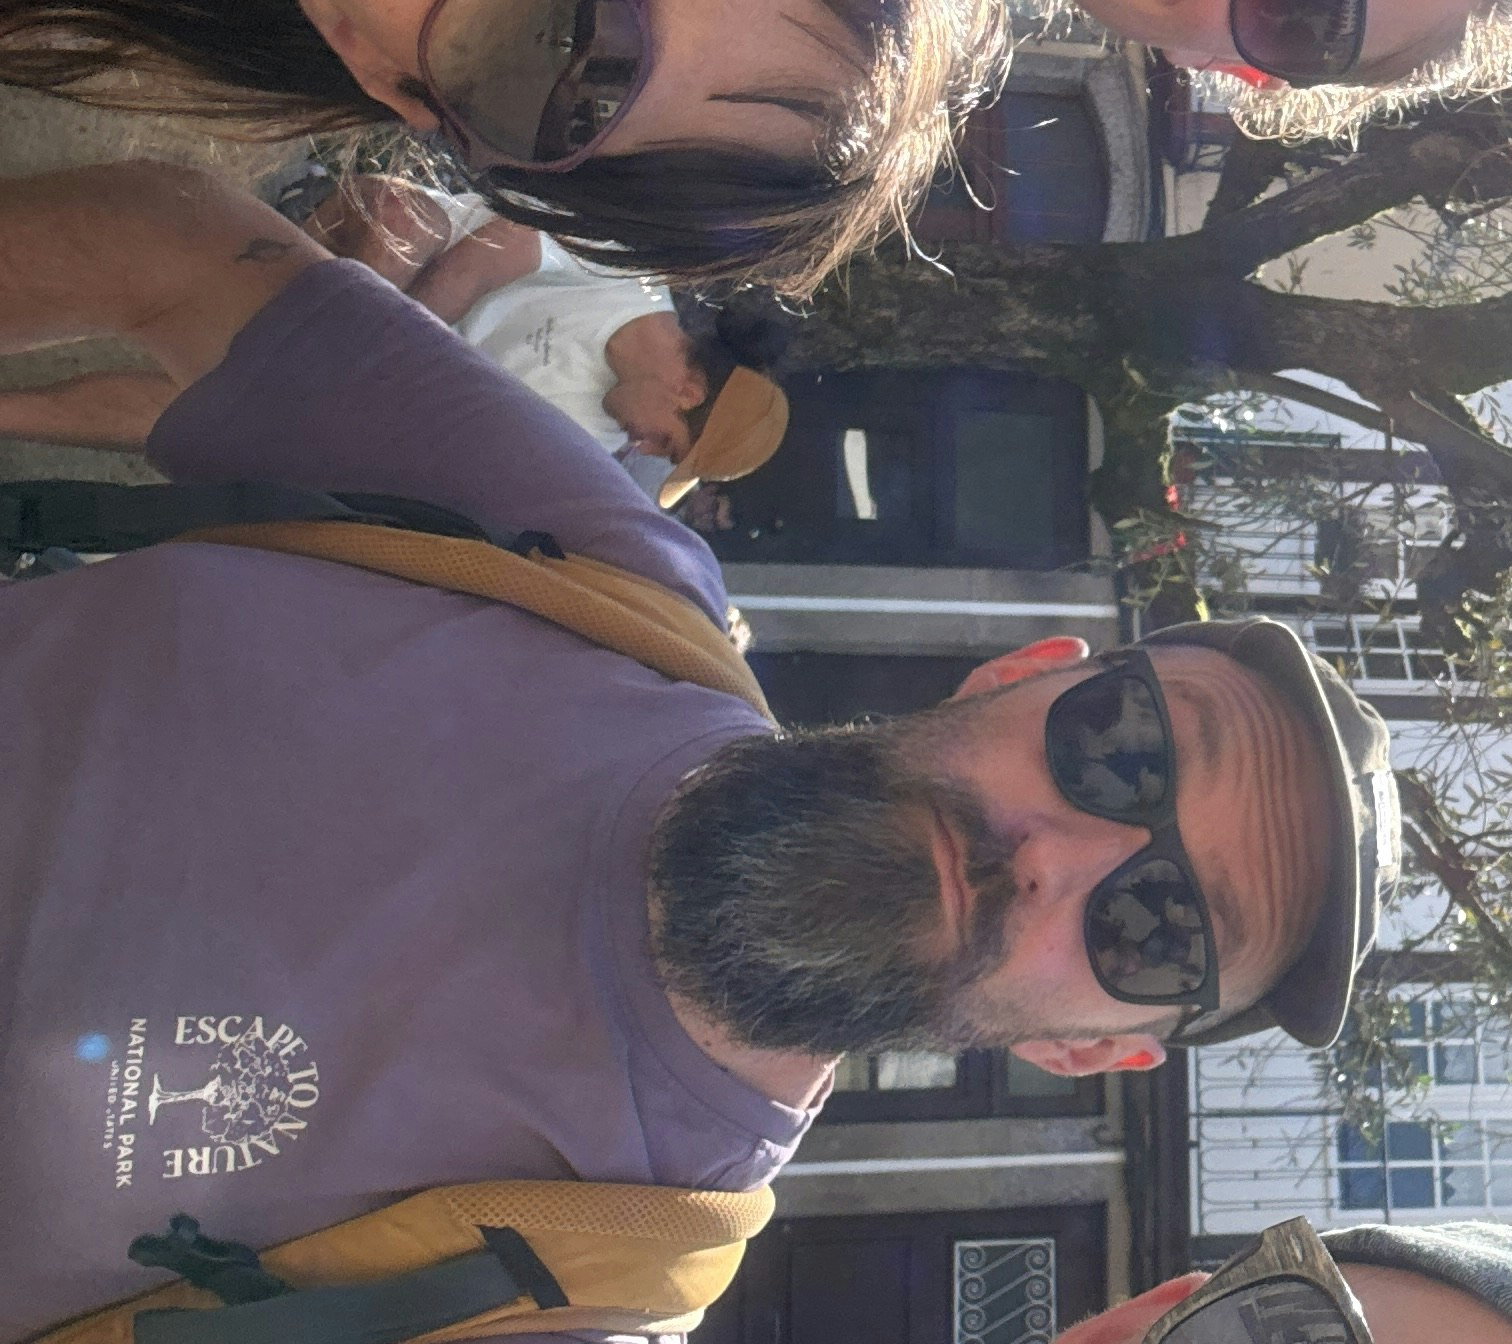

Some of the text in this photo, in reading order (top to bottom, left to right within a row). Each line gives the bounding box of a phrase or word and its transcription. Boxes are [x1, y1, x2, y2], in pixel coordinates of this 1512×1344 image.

[115, 1018, 147, 1189] NATIONAL PARK
[163, 1016, 319, 1178] ESCAPE TO NATURE
